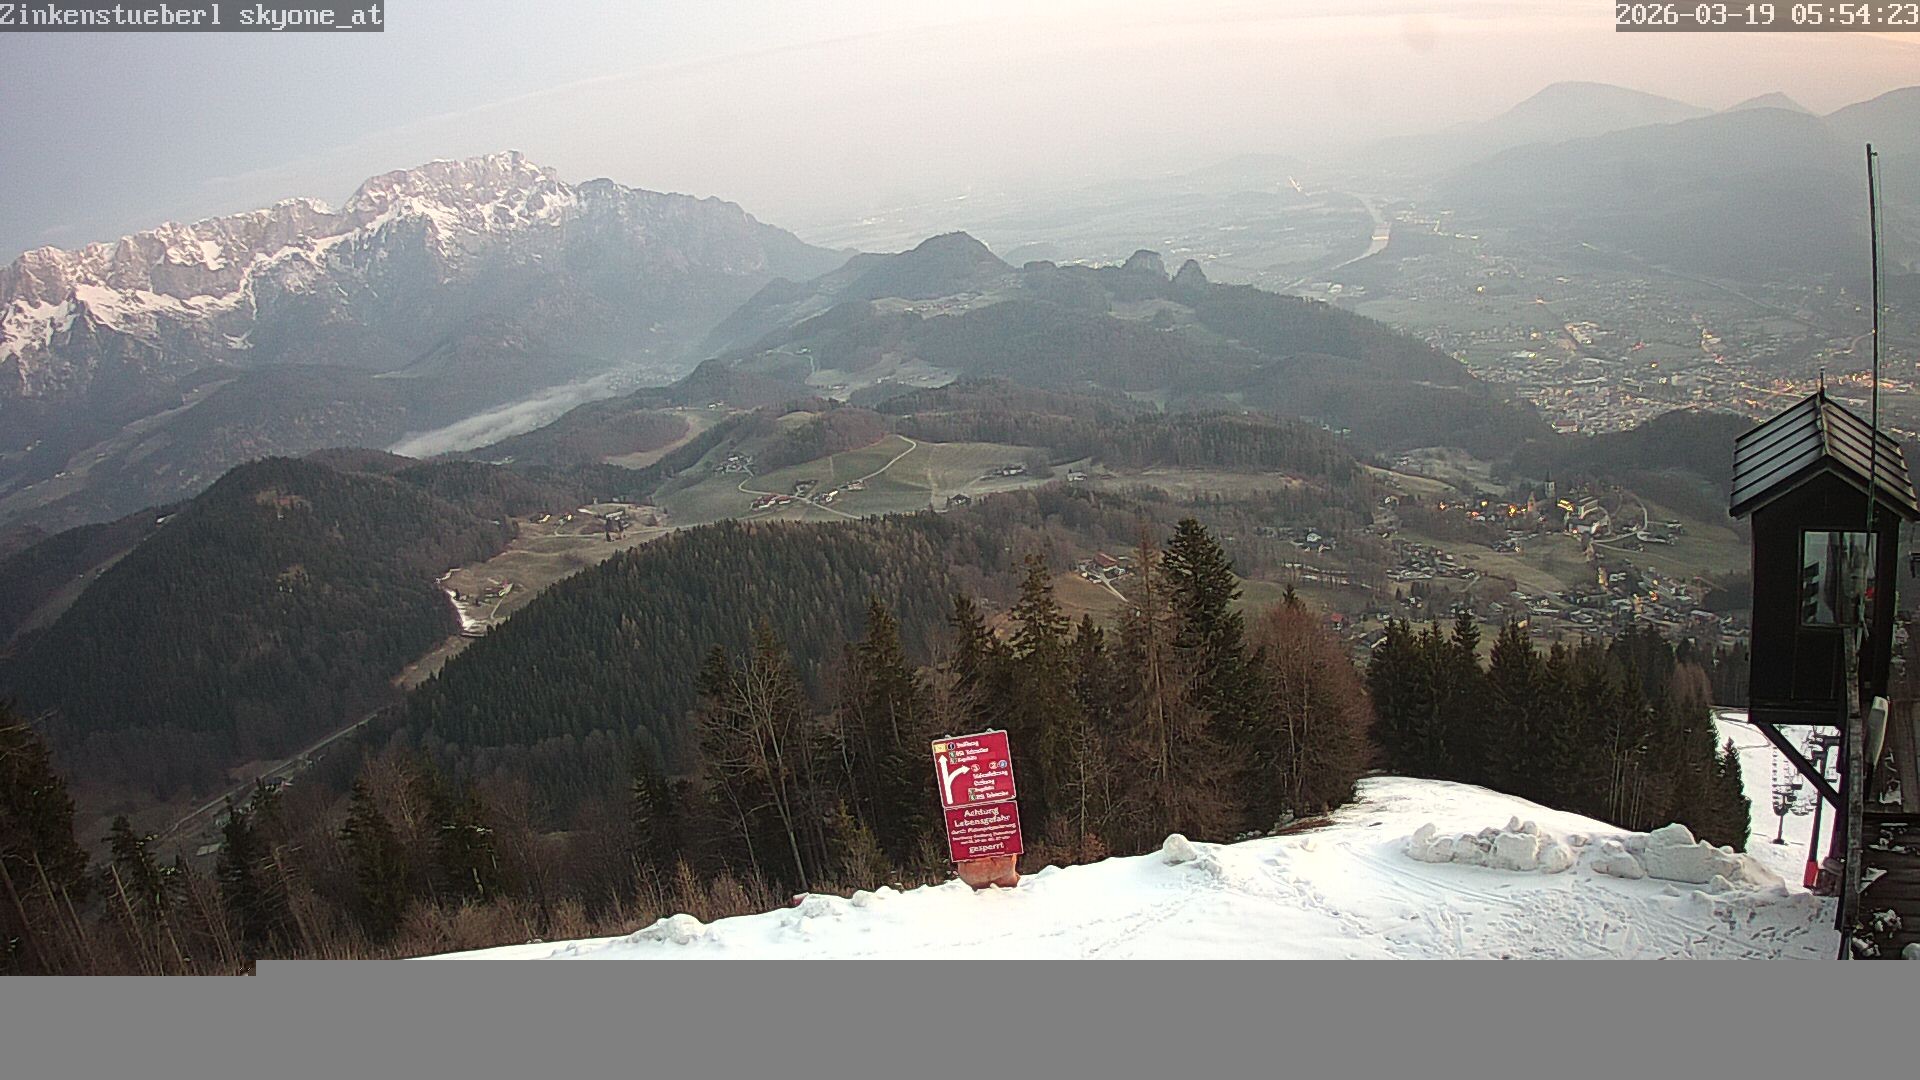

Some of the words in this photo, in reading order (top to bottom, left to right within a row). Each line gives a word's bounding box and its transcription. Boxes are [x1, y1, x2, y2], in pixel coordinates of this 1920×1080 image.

[964, 807, 999, 817] Achtung
[954, 814, 1010, 827] Lebensgefahr
[969, 842, 1004, 854] gesperrt
